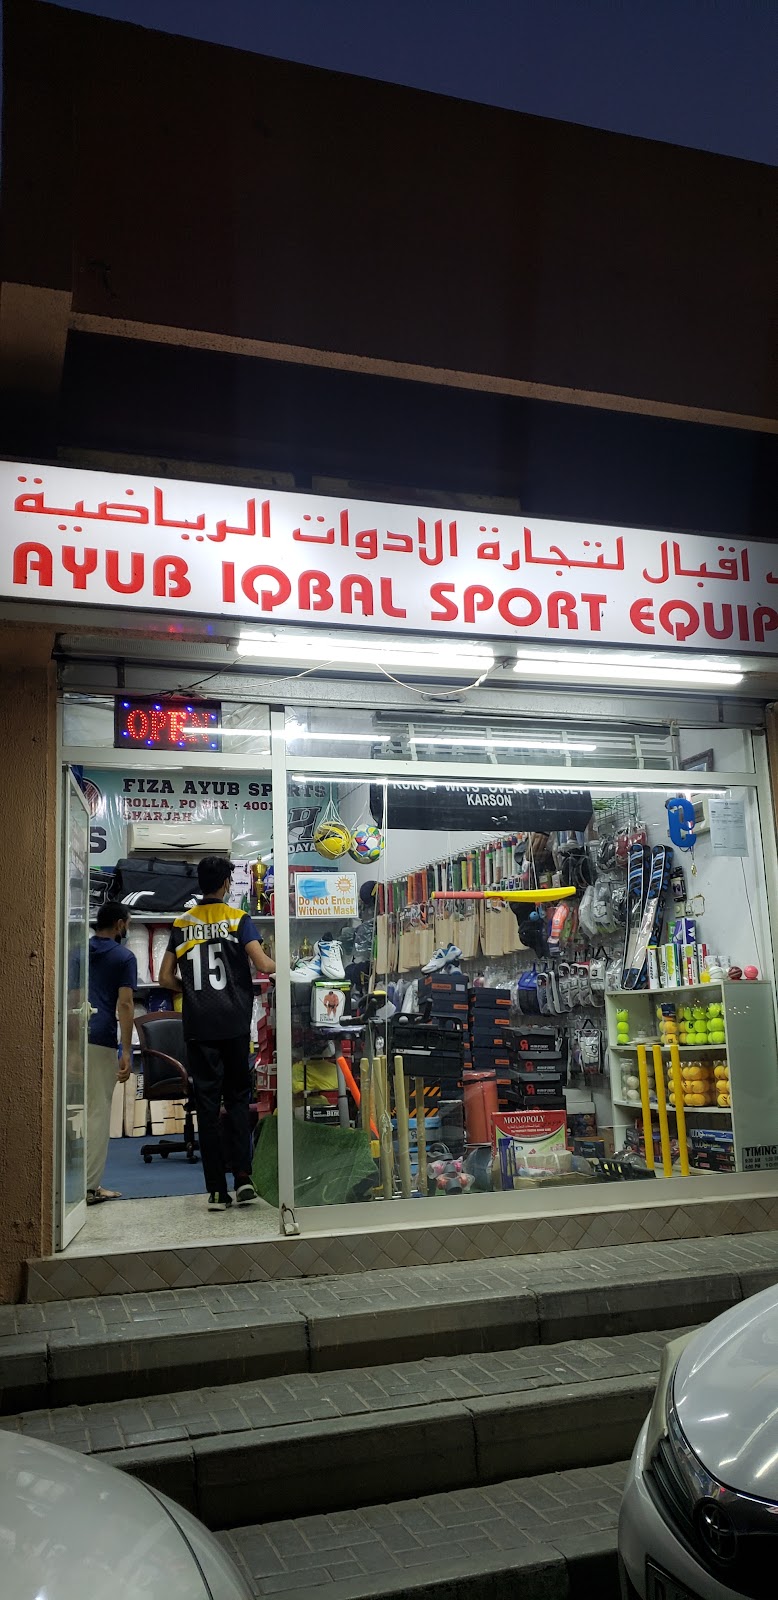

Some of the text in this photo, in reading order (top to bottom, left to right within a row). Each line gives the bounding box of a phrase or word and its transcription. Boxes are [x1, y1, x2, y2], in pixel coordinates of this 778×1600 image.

[13, 475, 750, 588] اقبال لتجارة الادوات الرياضية
[13, 541, 778, 642] AYUB IQBAL SPORT EQUIP
[126, 708, 211, 743] OPEN
[122, 778, 327, 799] FIZA AYUB SPRTS
[122, 797, 174, 809] ROLLA,
[179, 799, 197, 809] PO
[466, 793, 513, 807] KARSON
[123, 810, 193, 822] SHARJAH
[298, 895, 355, 906] Do Not Enter
[298, 905, 356, 916] Without Mask
[180, 922, 230, 941] TIGERS
[186, 943, 228, 992] 15
[503, 1115, 545, 1124] MONOPOLY
